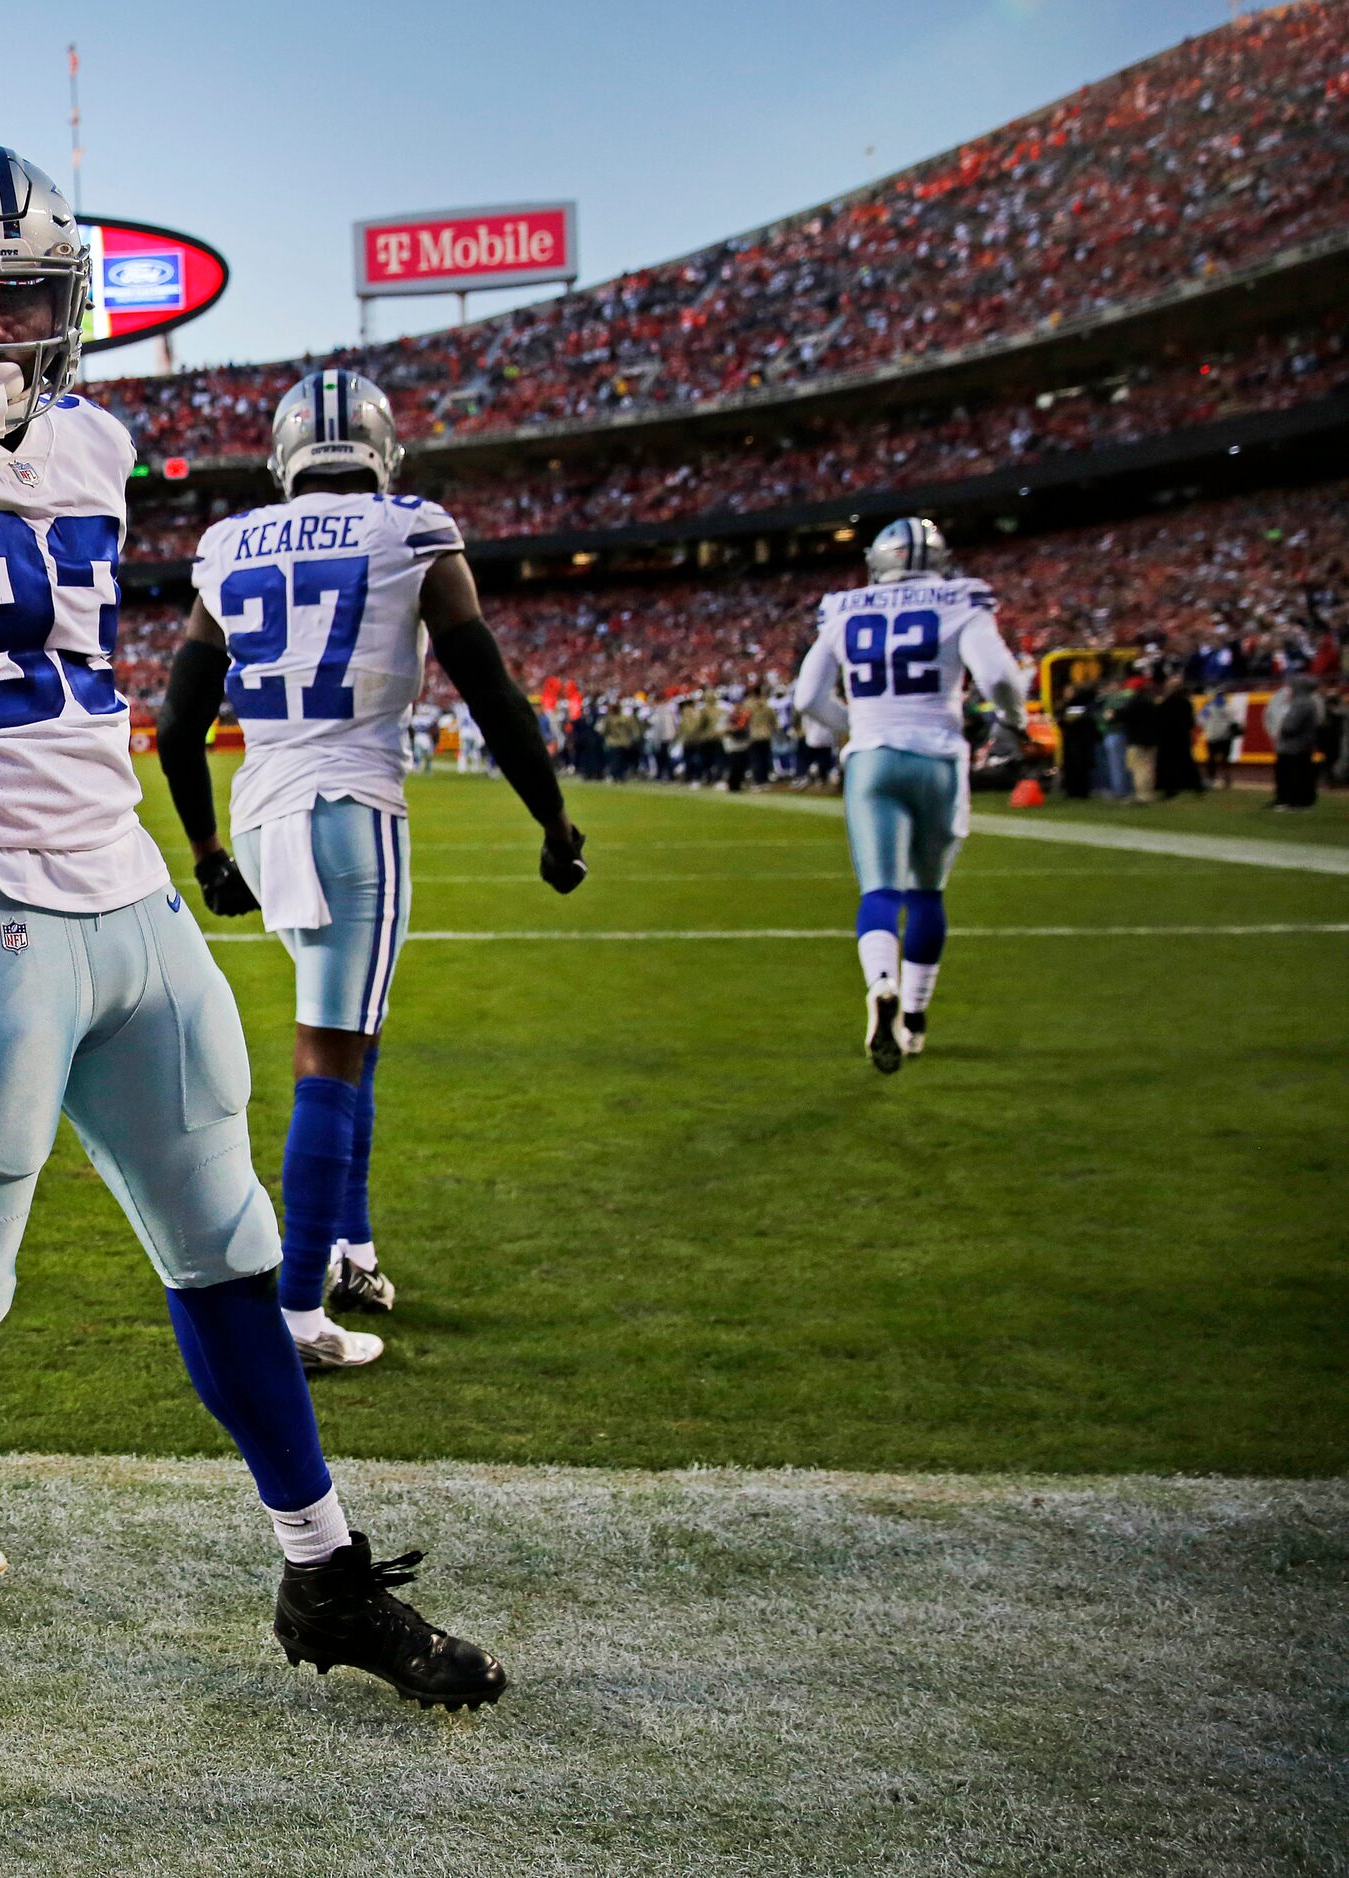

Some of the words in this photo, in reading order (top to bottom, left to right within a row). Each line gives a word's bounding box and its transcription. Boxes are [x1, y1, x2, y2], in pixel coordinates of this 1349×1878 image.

[417, 221, 554, 272] Mobile
[235, 516, 363, 560] KEARSE
[220, 555, 369, 720] 27
[845, 610, 940, 698] 92
[7, 934, 27, 947] NFL
